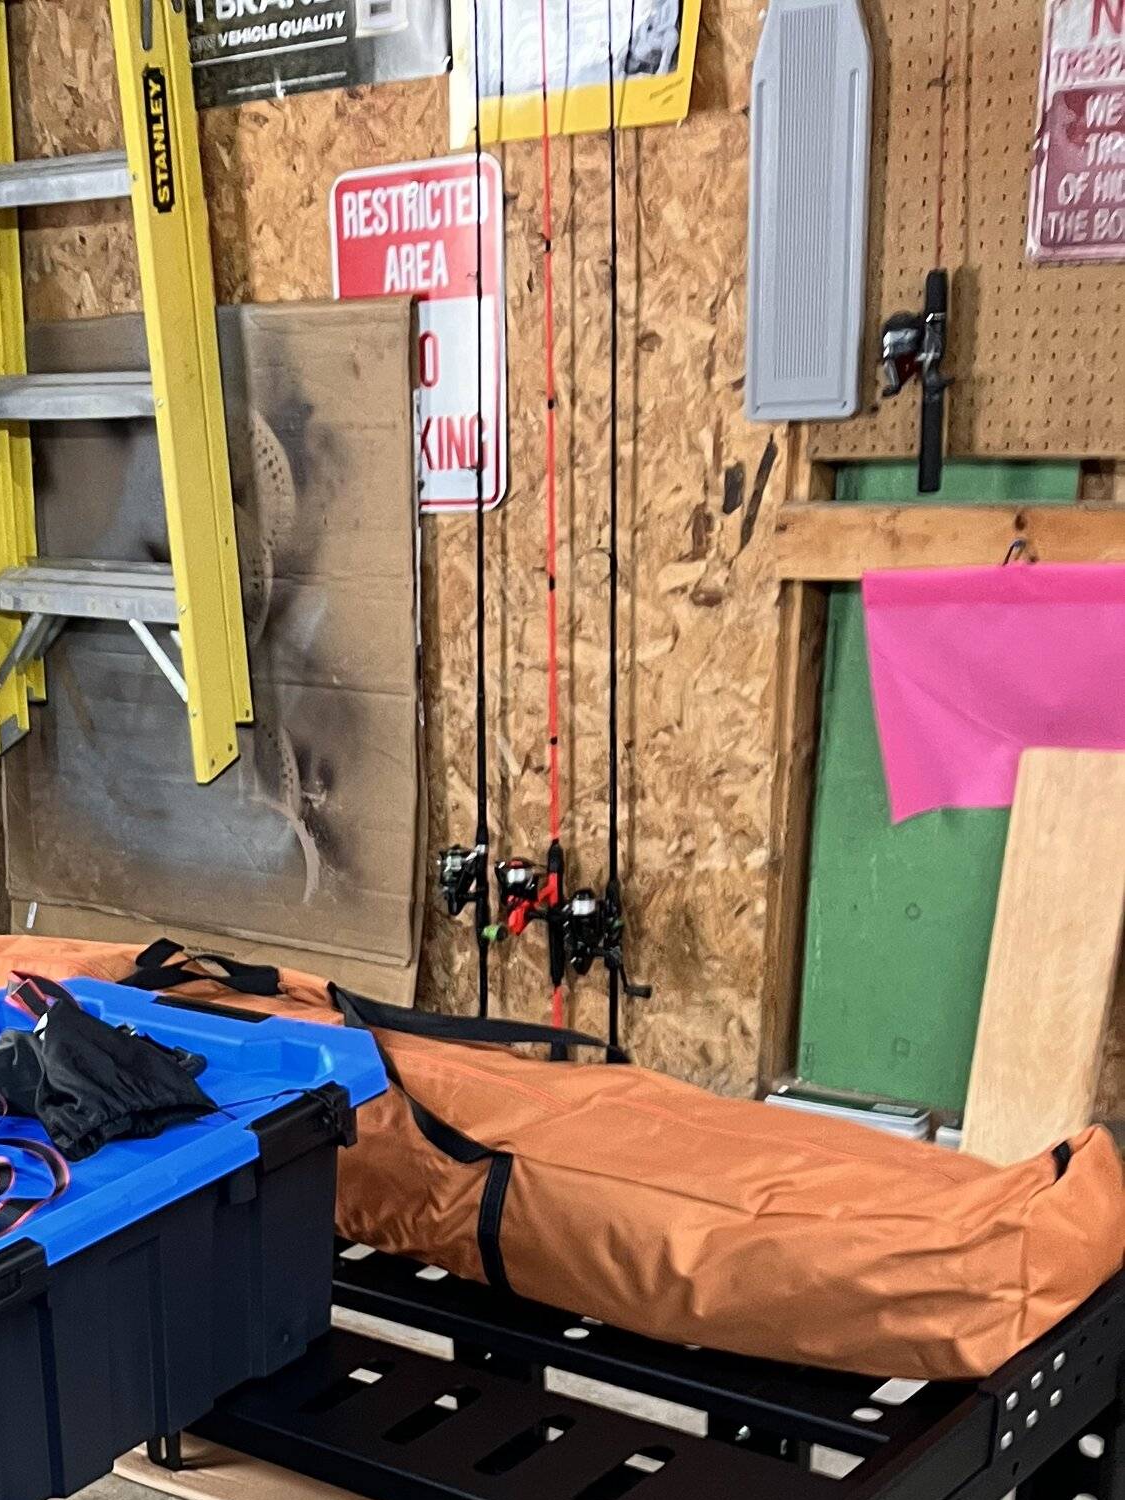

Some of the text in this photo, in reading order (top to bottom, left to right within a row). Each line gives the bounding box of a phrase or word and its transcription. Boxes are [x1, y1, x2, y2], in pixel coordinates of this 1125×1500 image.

[217, 23, 277, 48] VEHICLE
[278, 10, 346, 39] QUALITY
[148, 78, 170, 203] STANLEY
[342, 174, 490, 241] RESTRICTED
[1058, 171, 1090, 206] OF
[1047, 208, 1090, 243] THE
[384, 239, 450, 294] AREA
